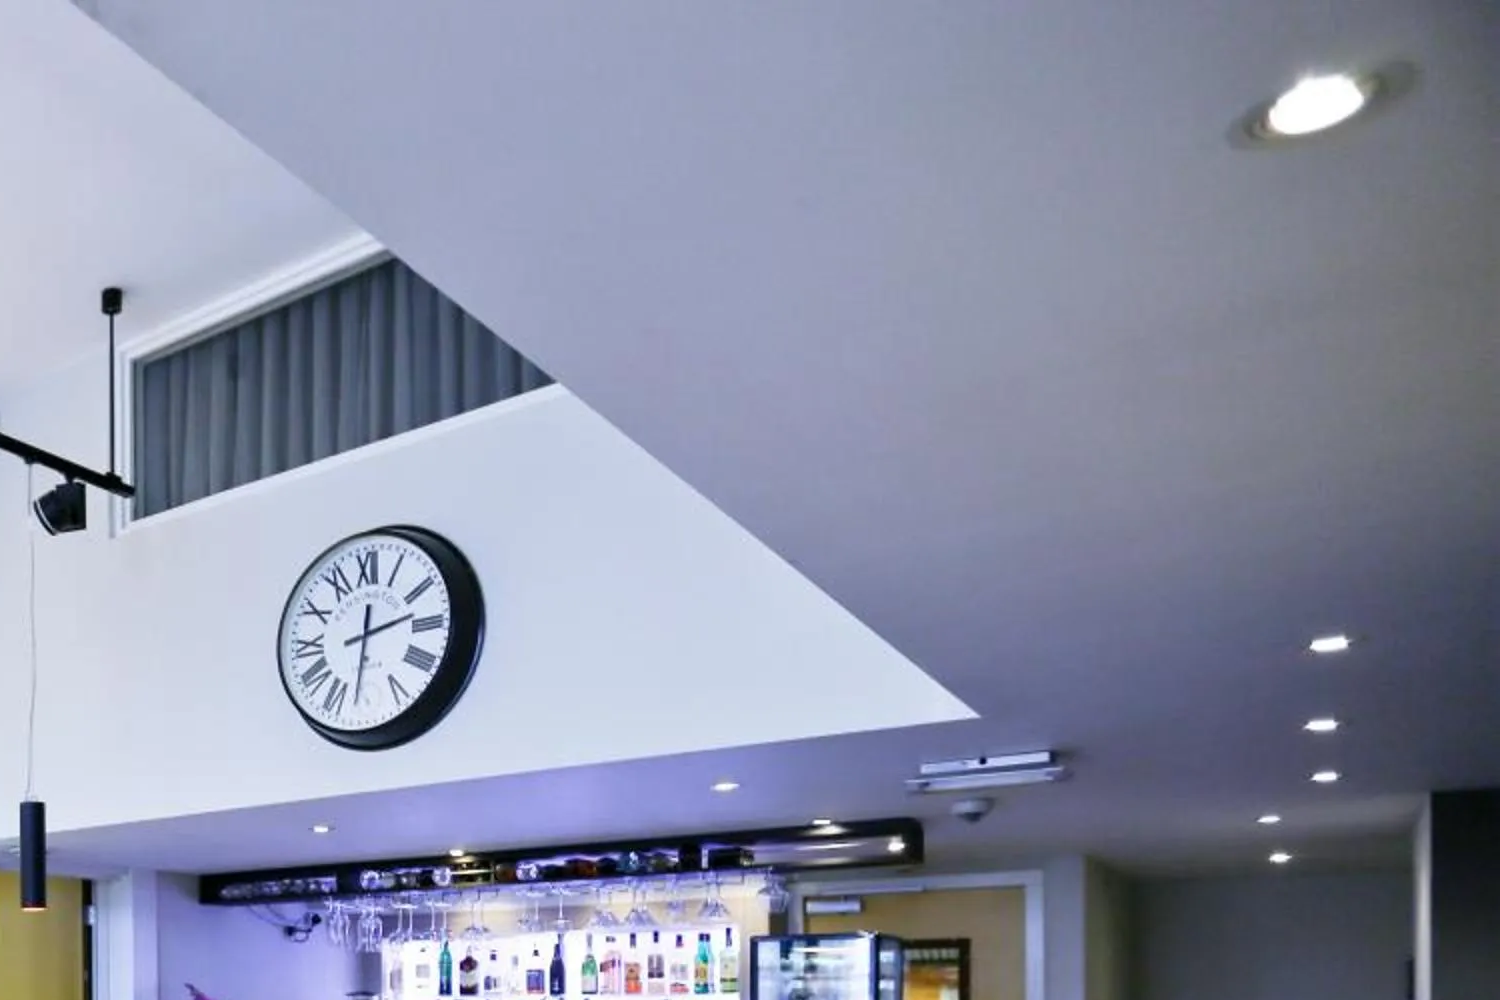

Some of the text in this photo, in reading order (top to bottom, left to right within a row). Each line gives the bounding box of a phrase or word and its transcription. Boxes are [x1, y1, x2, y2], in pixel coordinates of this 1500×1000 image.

[321, 563, 353, 604] XI
[404, 576, 435, 605] II
[303, 599, 333, 625] X
[411, 613, 444, 634] III
[387, 673, 411, 707] V
